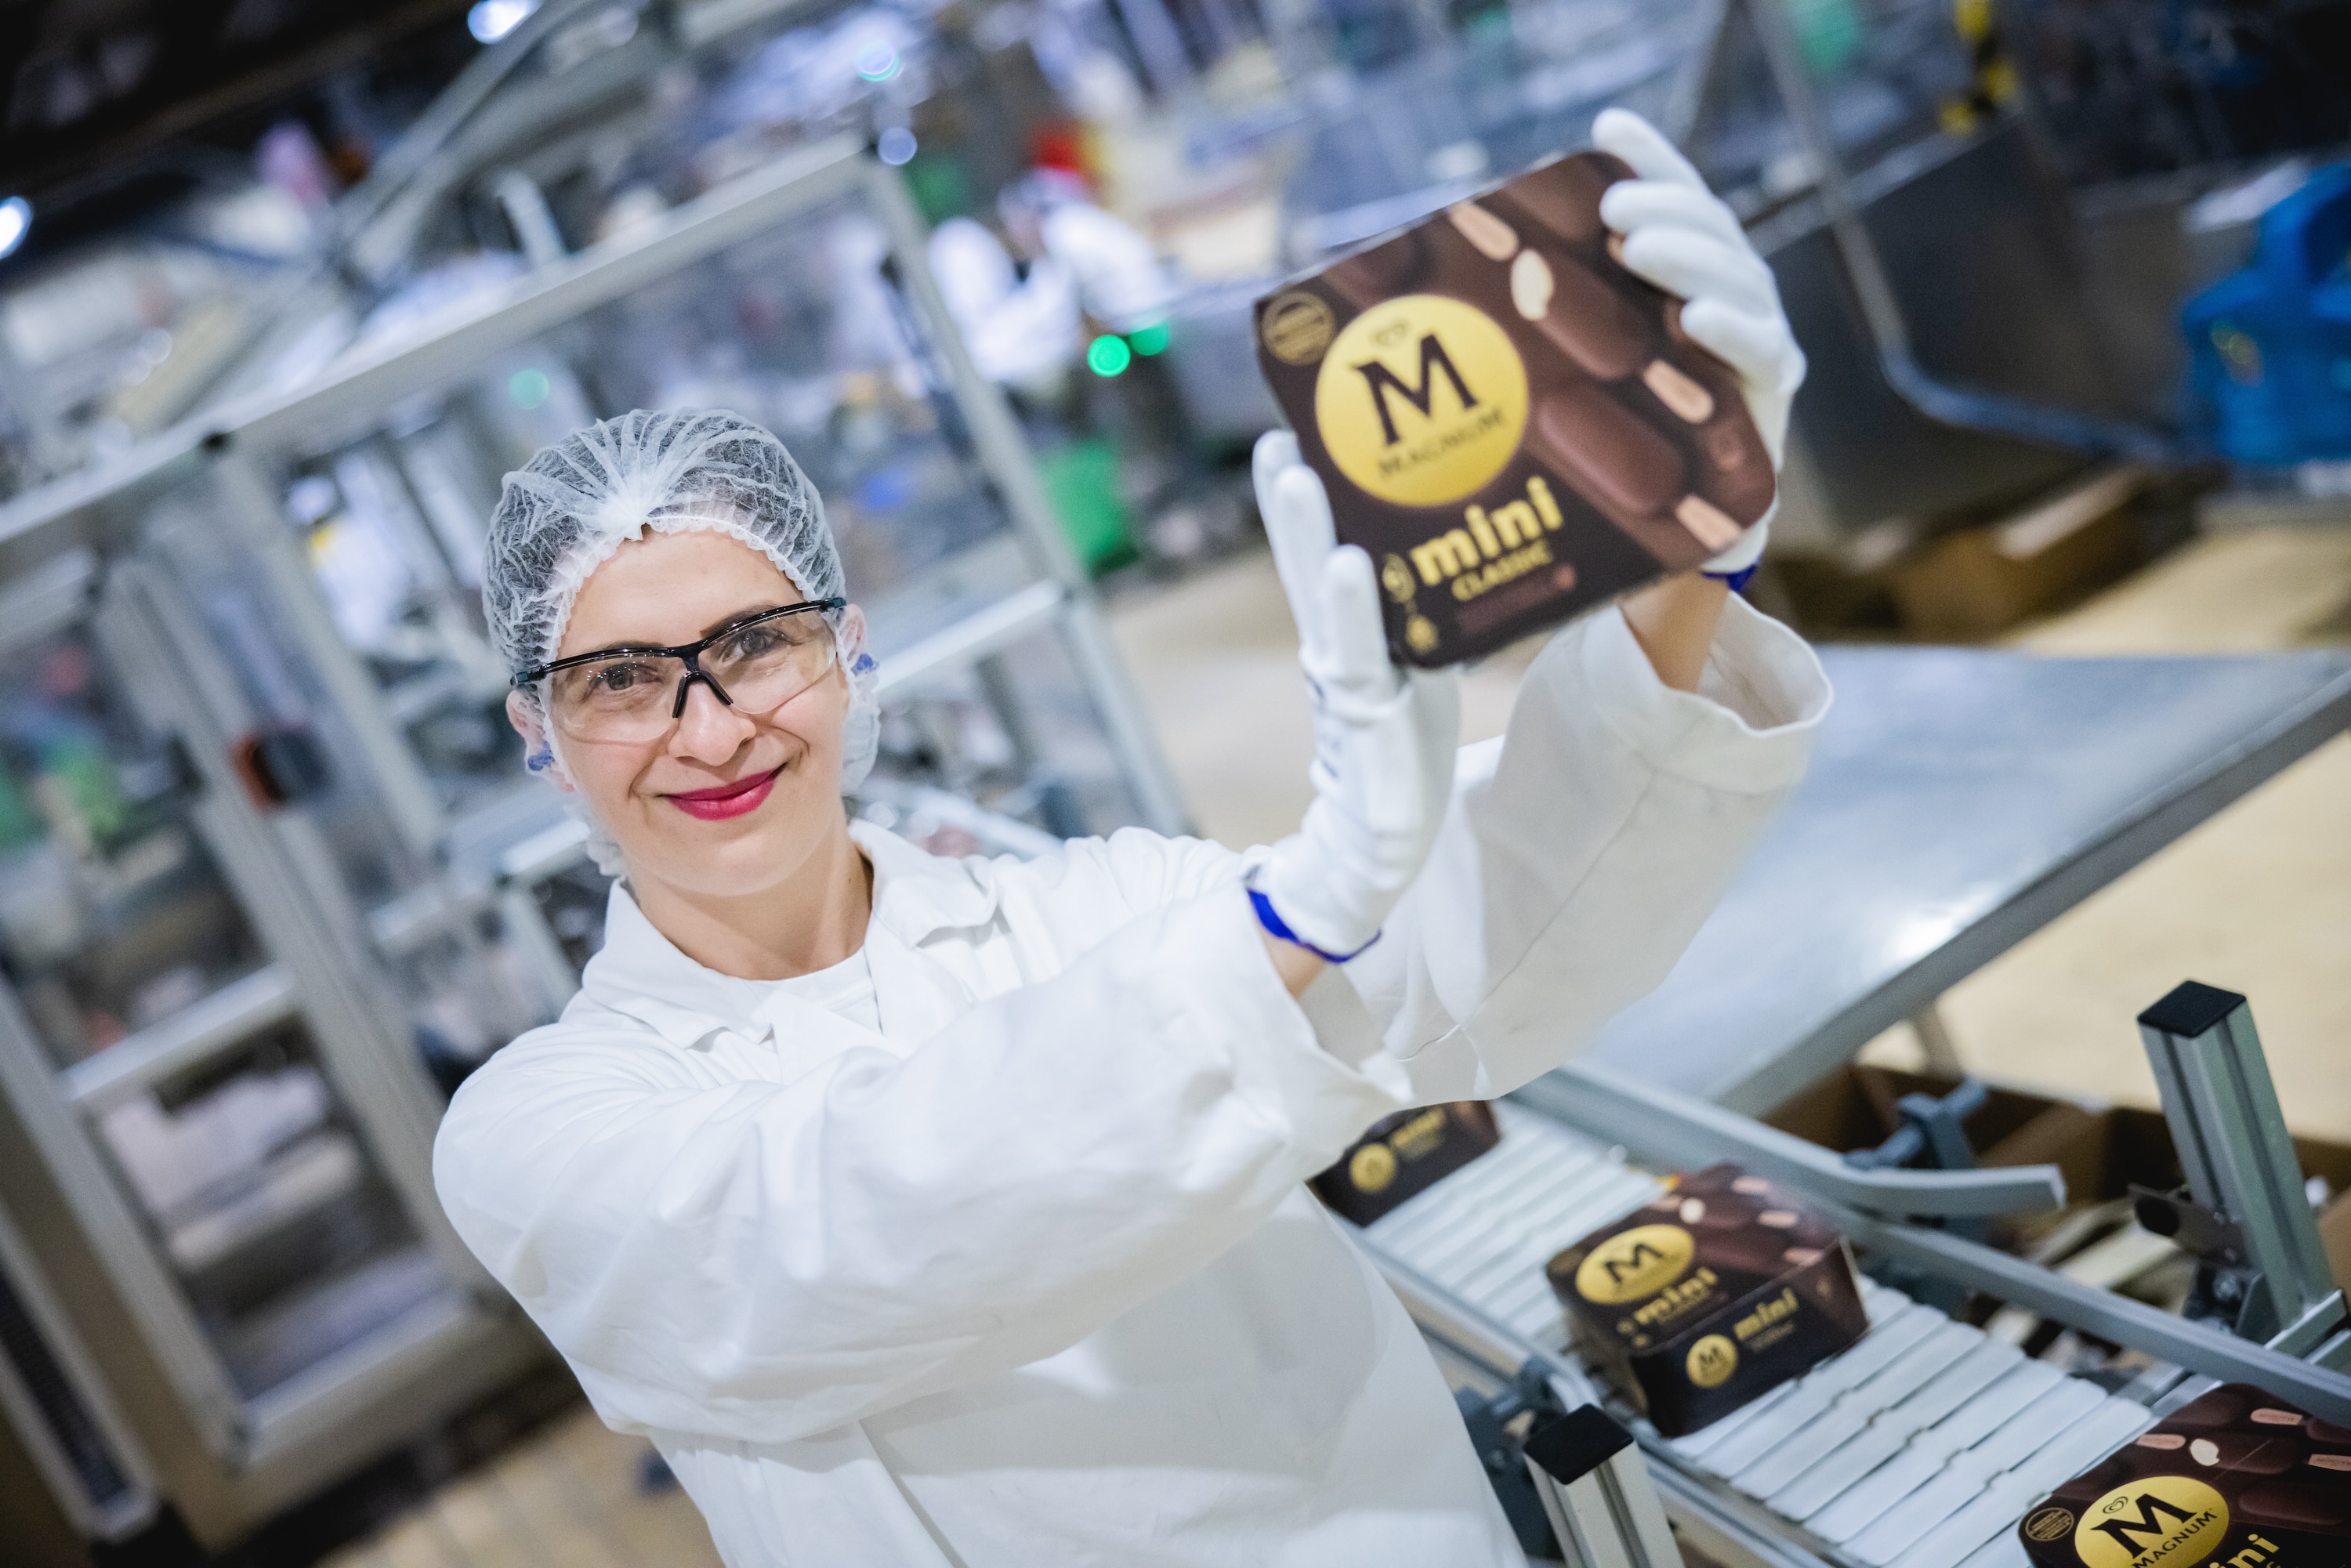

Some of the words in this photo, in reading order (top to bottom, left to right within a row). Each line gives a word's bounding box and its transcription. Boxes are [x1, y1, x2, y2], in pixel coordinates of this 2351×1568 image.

[1353, 333, 1480, 447] M
[1410, 476, 1563, 586] mini
[1603, 1242, 1664, 1284] M
[2090, 1493, 2197, 1559] M
[2132, 1510, 2218, 1568] MAGNUM
